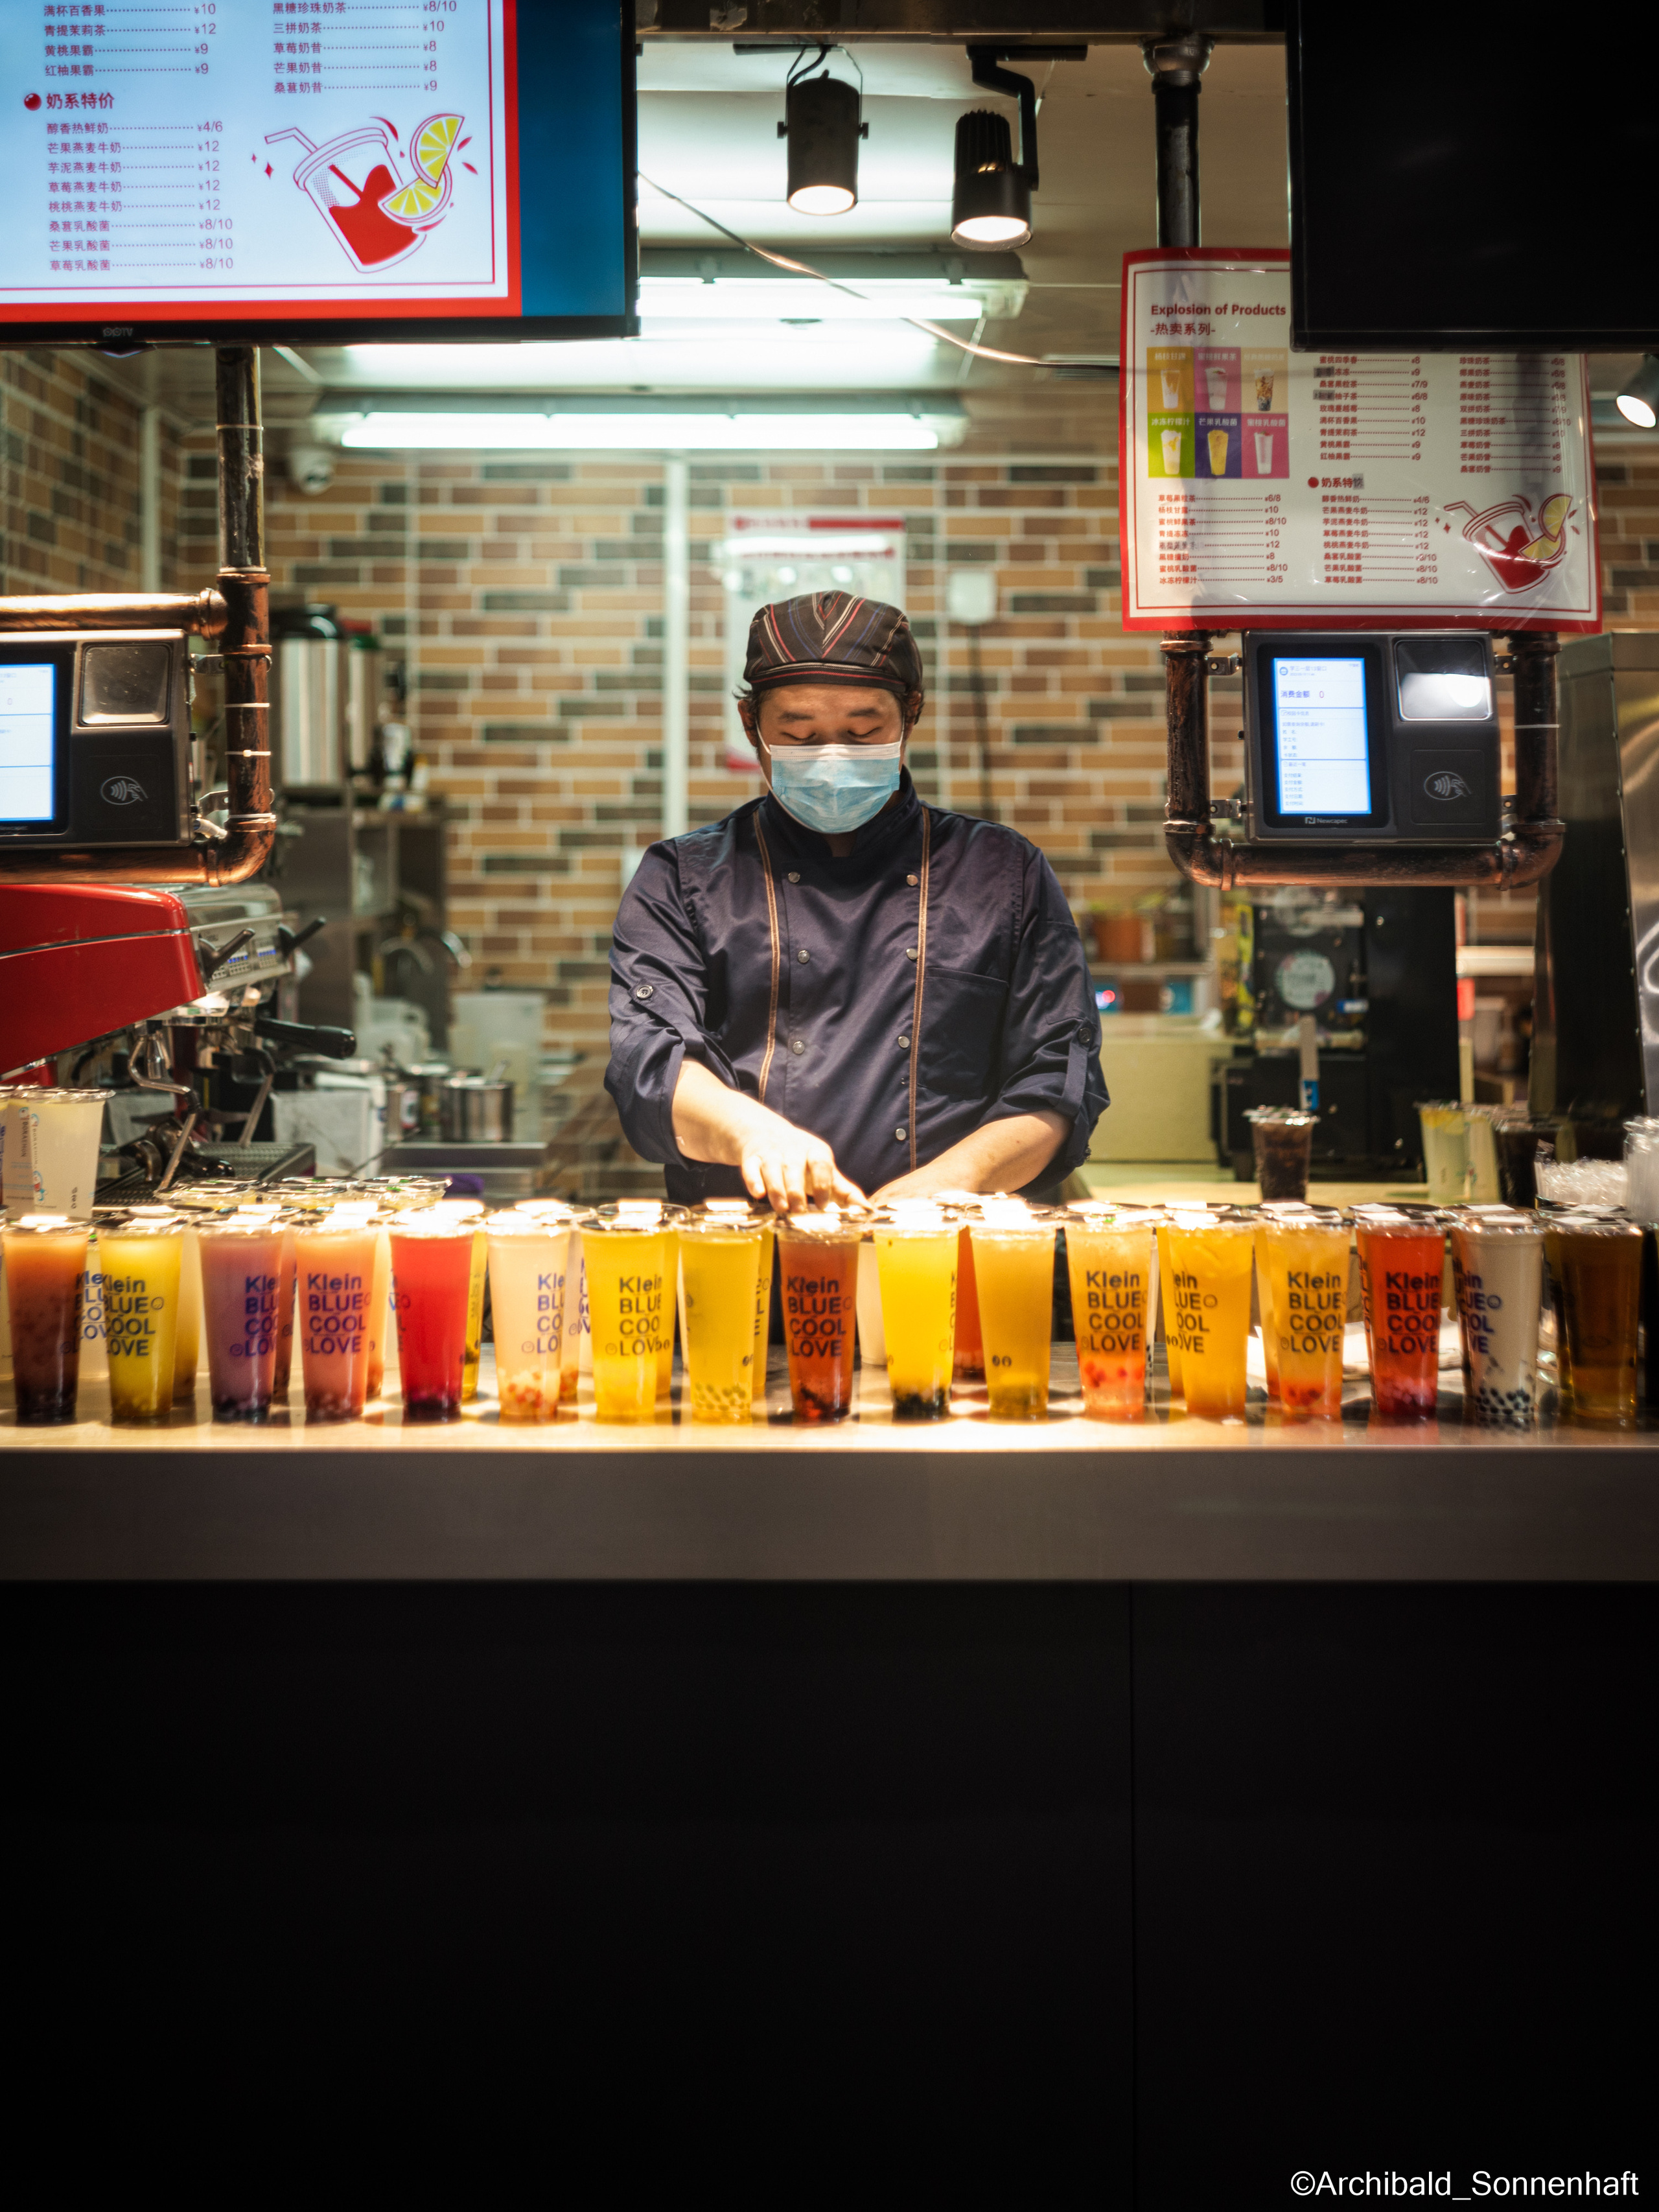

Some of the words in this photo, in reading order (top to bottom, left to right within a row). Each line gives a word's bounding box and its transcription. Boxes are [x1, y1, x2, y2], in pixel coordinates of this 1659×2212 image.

[44, 5, 106, 17] 满杯百香果
[273, 2, 347, 14] 黑糖珍珠奶茶
[44, 25, 106, 36] 青提茉莉茶
[273, 23, 322, 34] 三拼奶茶
[45, 45, 94, 57] 黄桃果霸
[273, 42, 322, 54] 草莓奶昔
[45, 65, 94, 76] 红柚果霸
[274, 62, 322, 74] 芒果奶昔
[46, 93, 115, 110] 奶系特价
[47, 122, 109, 135] 醇香热鲜奶
[47, 142, 121, 154] 芒果燕麦牛奶
[48, 162, 122, 174] 芋泥燕麦牛奶
[48, 181, 122, 193] 草莓燕麦牛奶
[49, 201, 122, 213] 桃桃燕麦牛奶
[49, 240, 110, 252] 芒果乳酸菌
[50, 259, 111, 272] 草莓乳酸菌
[1151, 305, 1210, 316] Explosion
[1214, 305, 1227, 316] of
[1232, 304, 1286, 316] Products
[307, 1274, 362, 1290] Klein
[787, 1276, 839, 1295] Klein
[1086, 1271, 1140, 1289] Klein
[1288, 1271, 1341, 1290] Klein
[1386, 1271, 1439, 1290] Klein
[308, 1293, 363, 1311] BLUE
[787, 1296, 842, 1315] BLUE
[1088, 1291, 1141, 1310] BLUE
[1289, 1292, 1341, 1310] BLUE
[1387, 1292, 1439, 1311] BLUE
[309, 1314, 366, 1333] COOL
[620, 1315, 660, 1335] COO
[789, 1318, 846, 1336] COOL
[1089, 1313, 1144, 1331] COOL
[1290, 1314, 1343, 1332] COOL
[310, 1336, 362, 1354] LOVE
[791, 1339, 842, 1357] LOVE
[1091, 1334, 1141, 1352] LOVE
[1291, 1335, 1340, 1353] LOVE
[1388, 1335, 1437, 1354] LOVE
